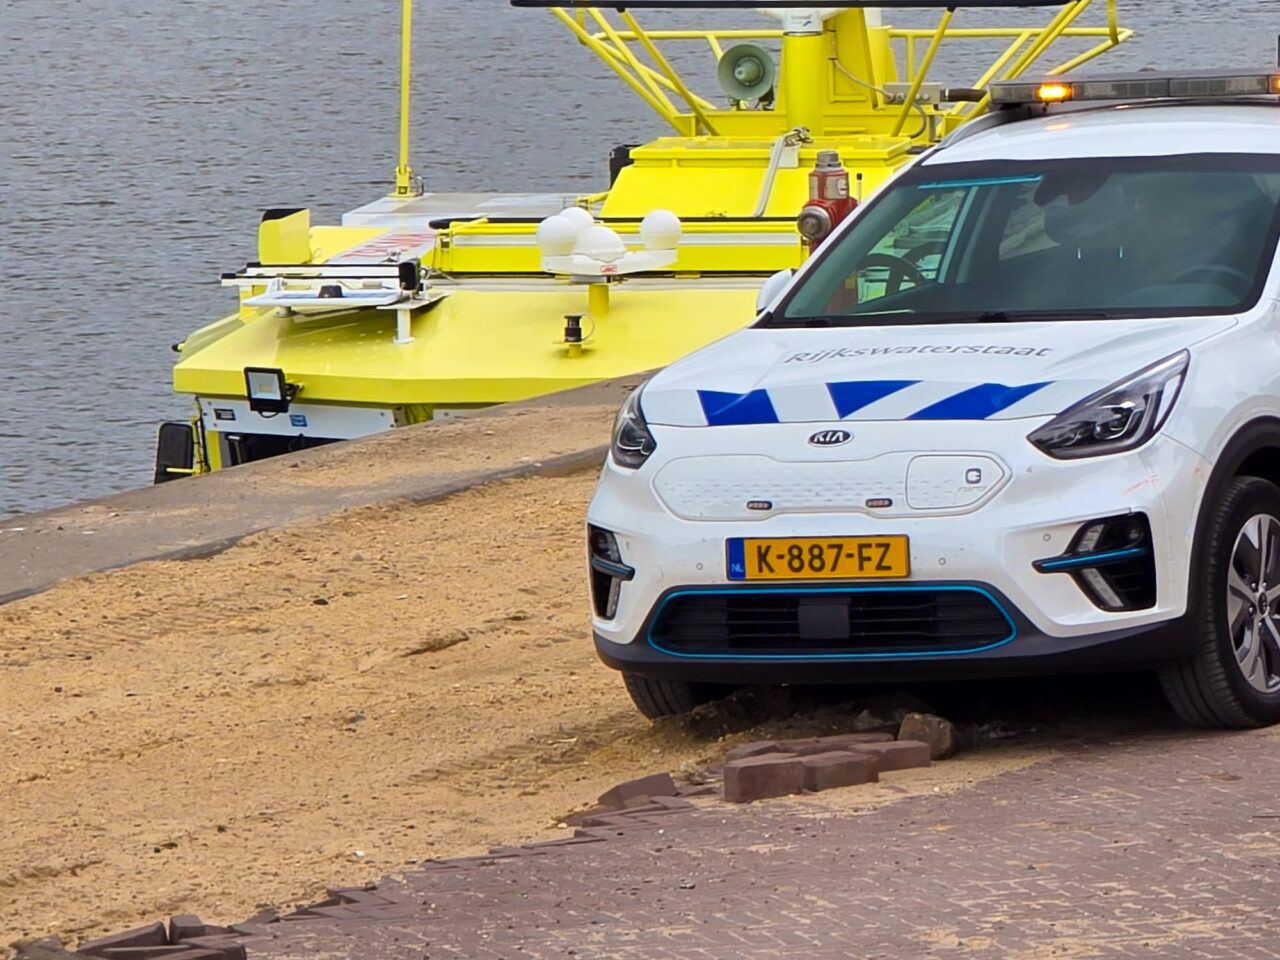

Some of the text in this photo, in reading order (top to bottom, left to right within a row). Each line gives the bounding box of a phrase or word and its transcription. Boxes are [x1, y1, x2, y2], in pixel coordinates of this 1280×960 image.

[784, 344, 1054, 364] Rijkswaterstaat
[813, 430, 845, 443] KIA
[756, 543, 893, 573] K-887-FZ
[731, 563, 745, 573] NL
